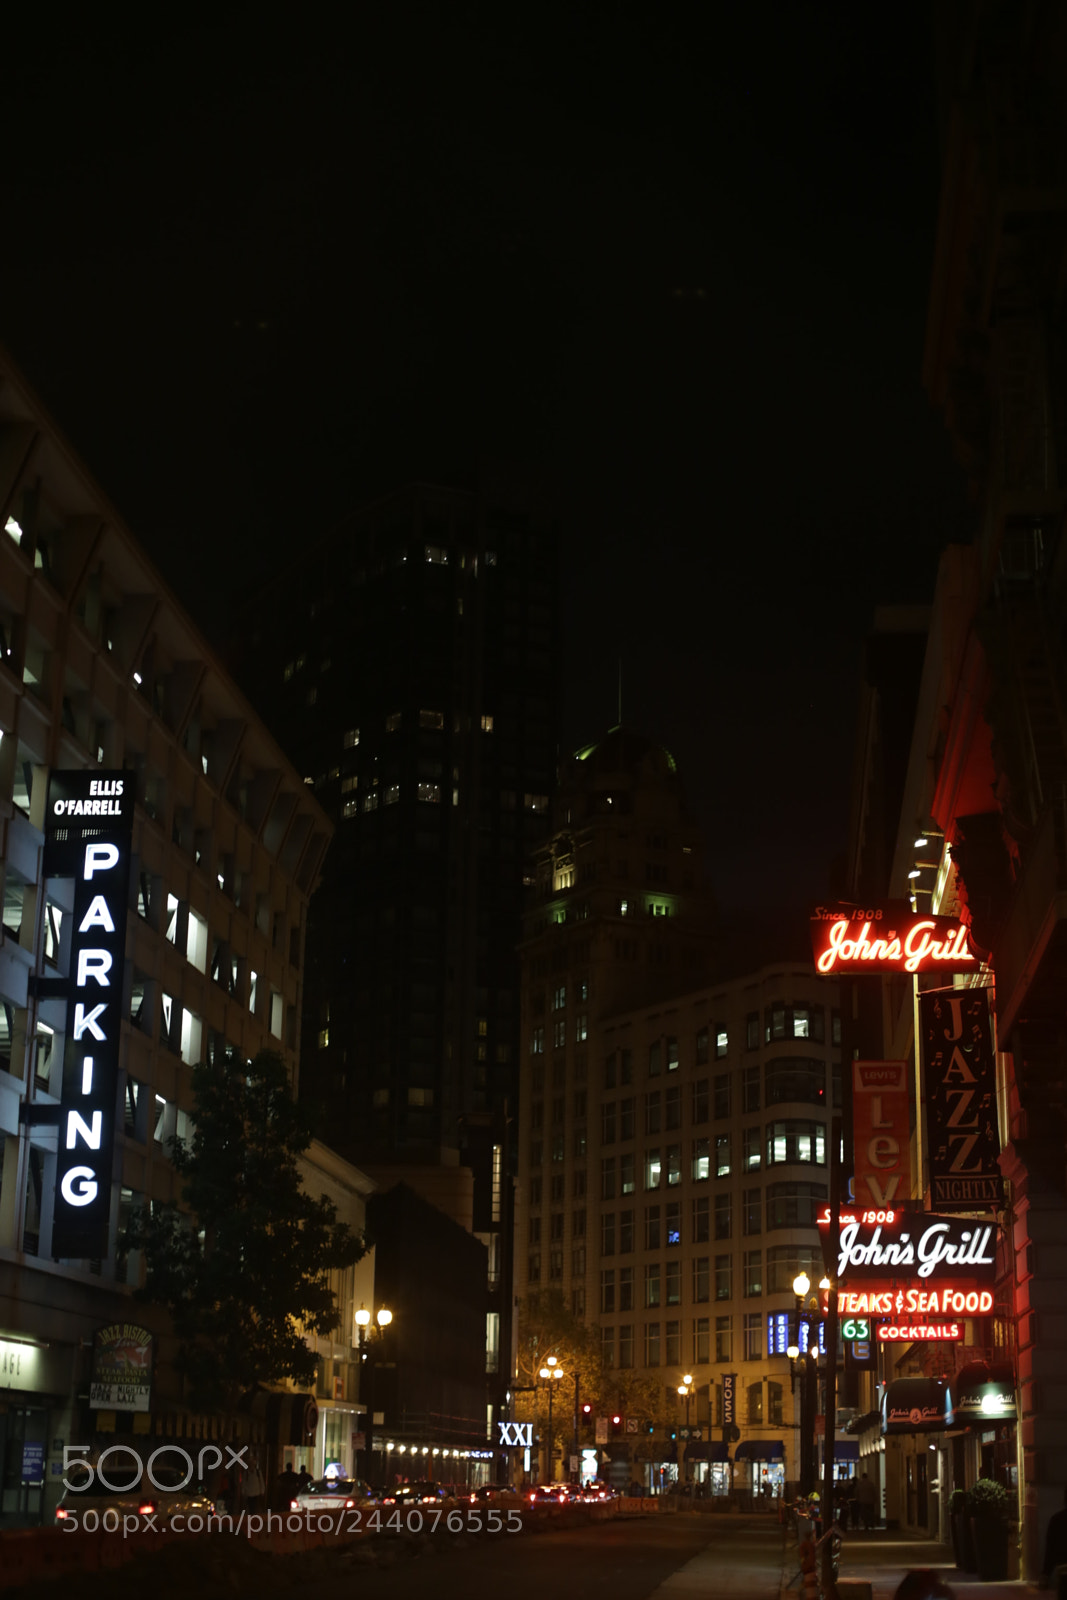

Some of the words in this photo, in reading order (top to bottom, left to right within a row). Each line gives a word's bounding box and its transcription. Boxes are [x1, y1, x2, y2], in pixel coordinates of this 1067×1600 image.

[89, 780, 124, 796] ELLIS
[54, 800, 122, 815] O'FARRELL
[811, 907, 847, 920] Since
[852, 910, 883, 920] 1908
[818, 920, 902, 972] John's
[61, 843, 120, 1206] PARKING
[942, 998, 982, 1172] JAZZ
[935, 1179, 999, 1200] NIGHTLY
[863, 1210, 895, 1223] 1908
[837, 1223, 914, 1277] John's
[917, 1223, 994, 1277] Grill
[823, 1292, 893, 1313] TEAKS
[777, 1315, 785, 1353] ROSS
[843, 1319, 869, 1339] 63
[879, 1325, 959, 1339] COCKTAILS
[724, 1377, 732, 1423] ROSS
[498, 1422, 533, 1446] XXI
